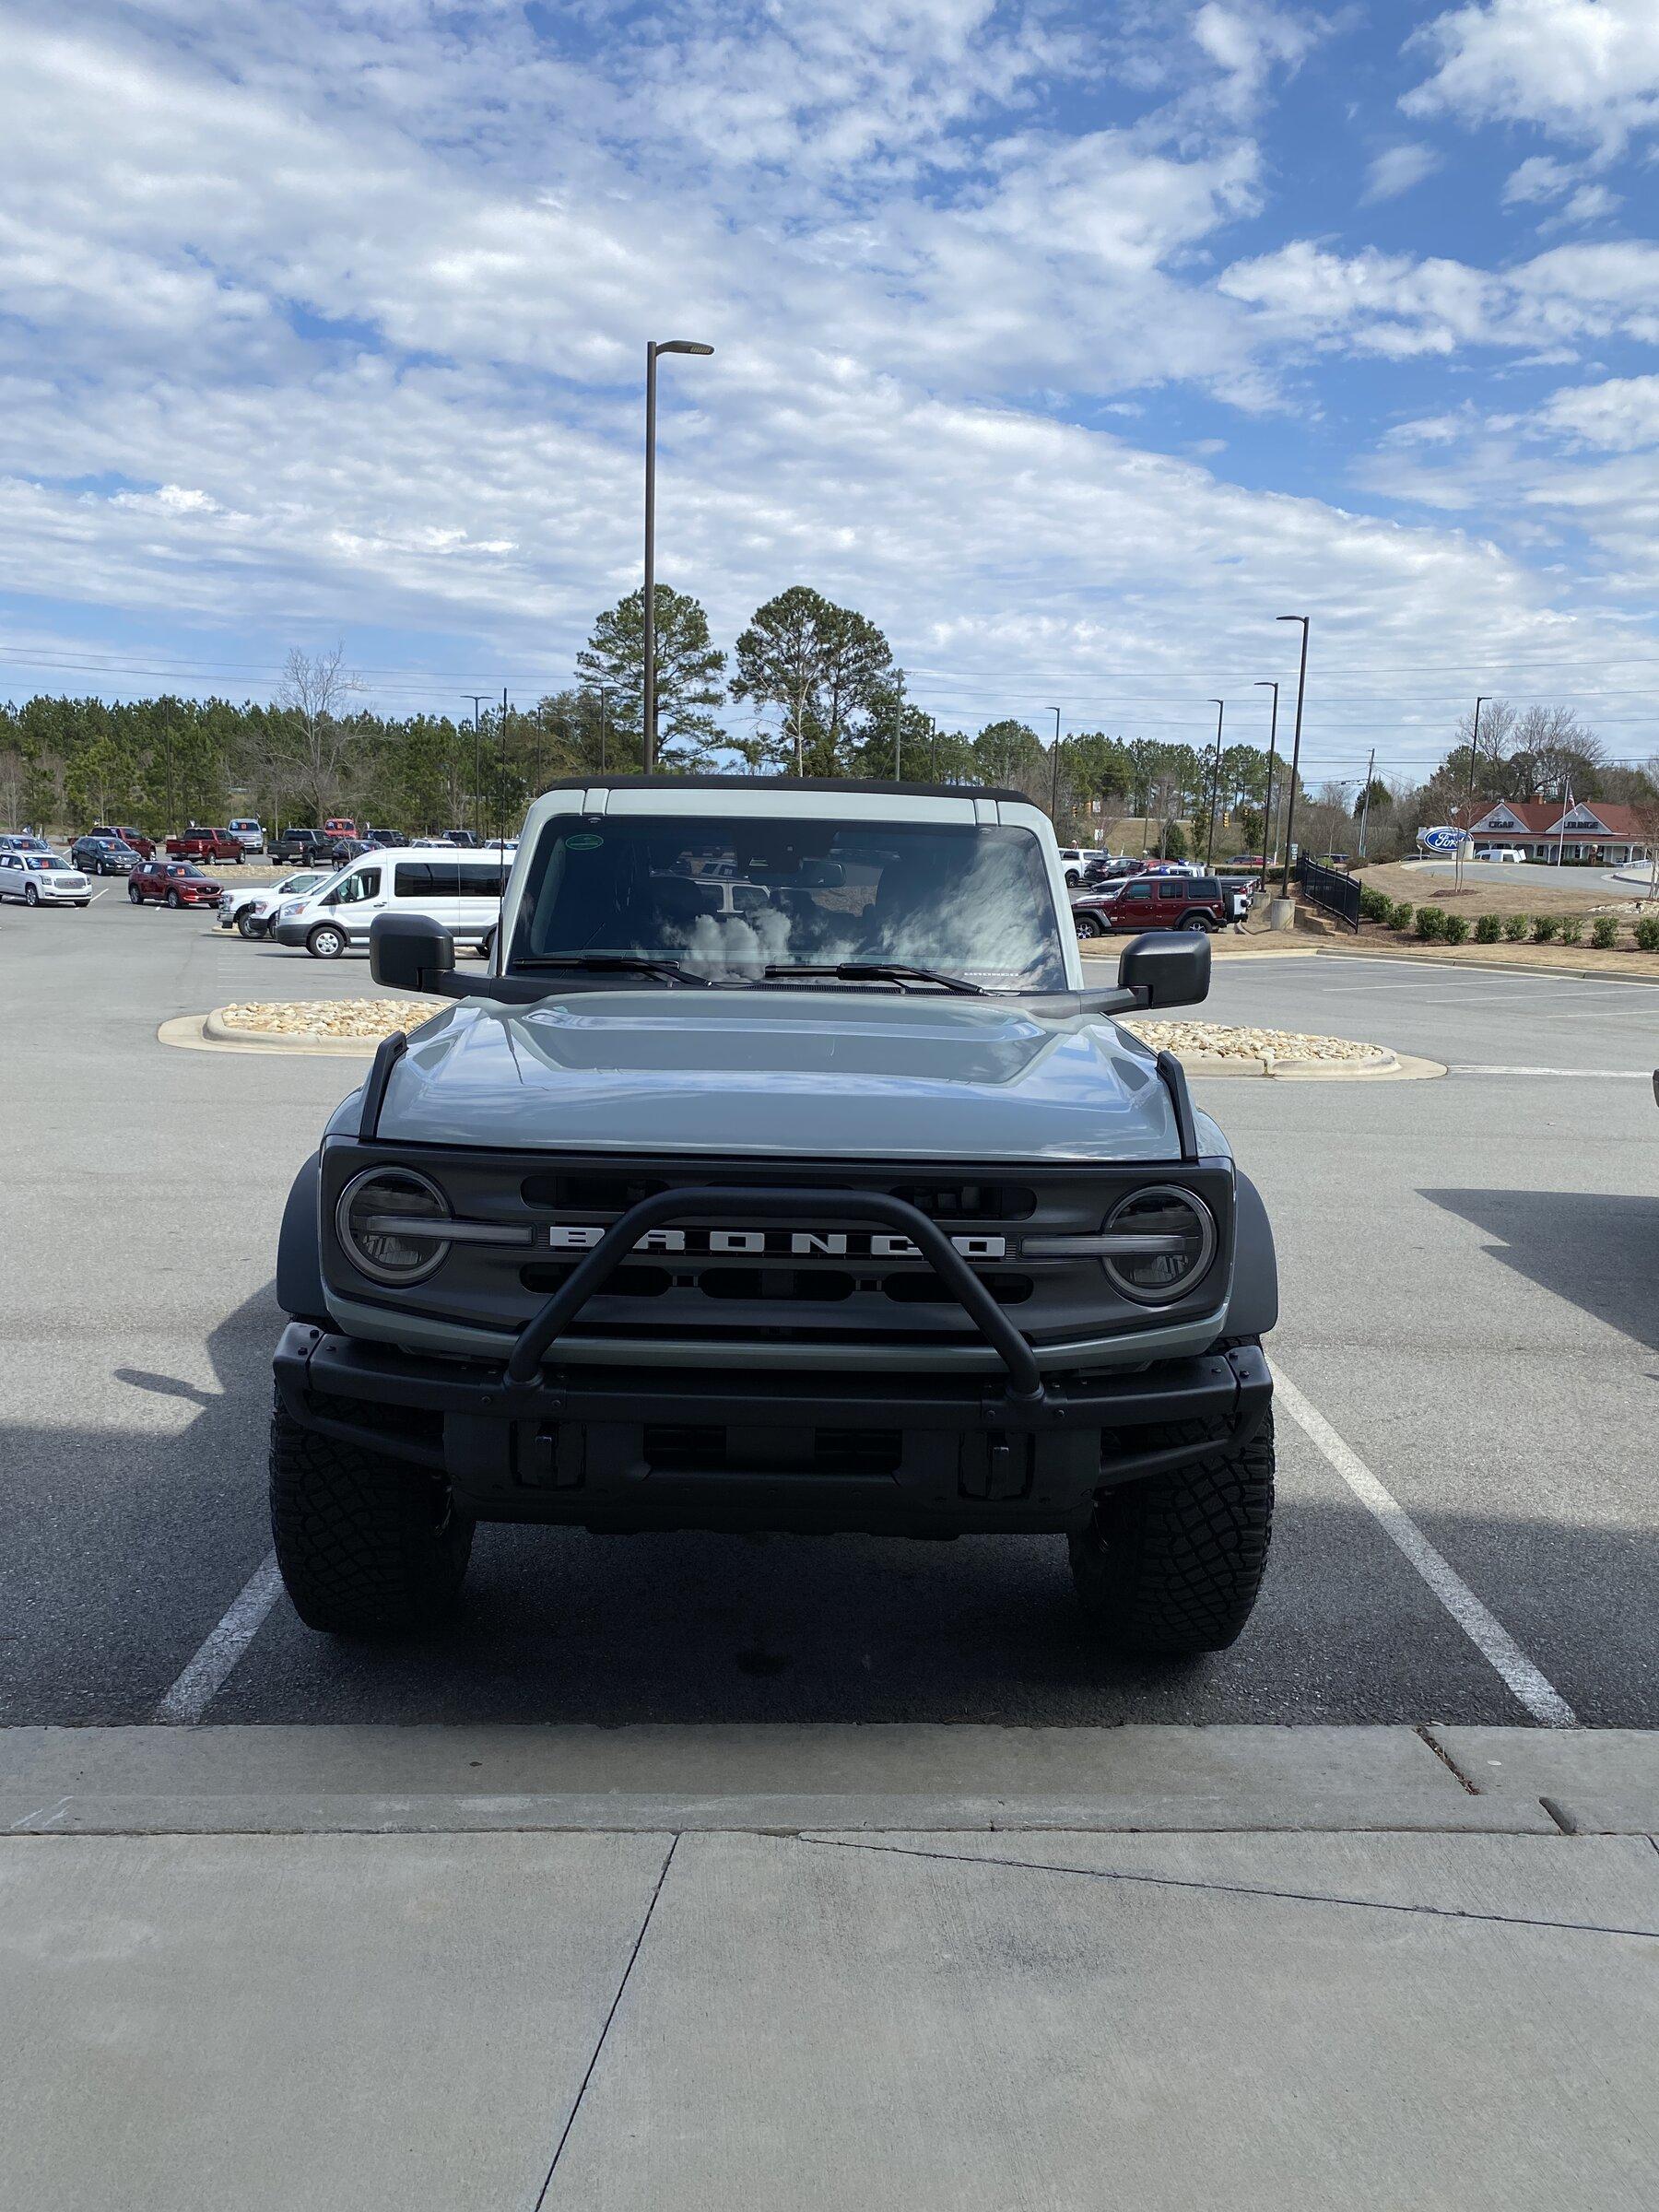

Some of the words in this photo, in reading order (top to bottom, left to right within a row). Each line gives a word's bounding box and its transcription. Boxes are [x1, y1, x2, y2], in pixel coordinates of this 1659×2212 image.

[1488, 820, 1514, 829] CIGAR
[1563, 821, 1599, 830] LOUNGE
[549, 1226, 1006, 1257] BRONCO
